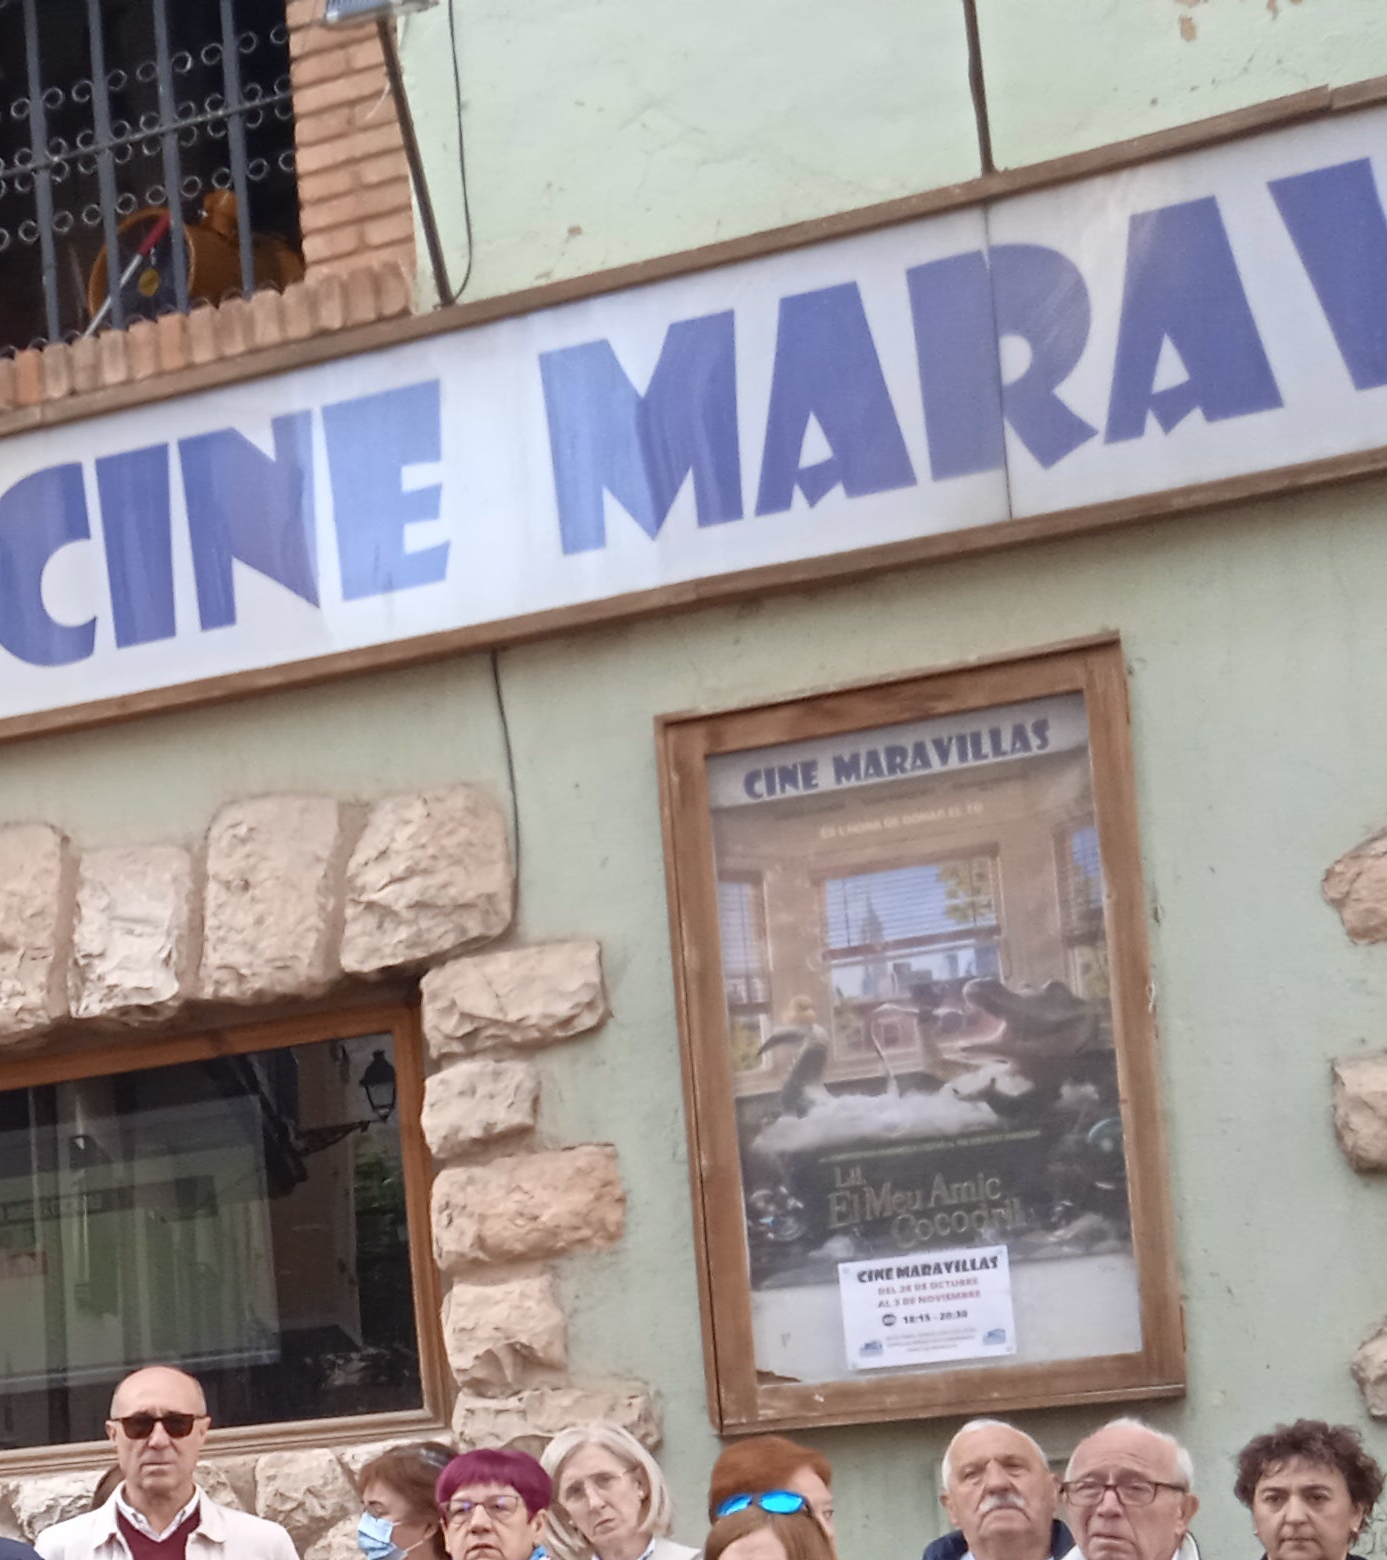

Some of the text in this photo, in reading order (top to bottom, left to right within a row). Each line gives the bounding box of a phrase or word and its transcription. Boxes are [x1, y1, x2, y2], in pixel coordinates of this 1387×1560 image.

[743, 718, 1050, 800] CINE MARAVILLAS
[928, 1171, 1002, 1208] Amic
[857, 1256, 998, 1284] CINE MARAVILLAS
[930, 1277, 979, 1290] OCTUBRE
[902, 1296, 916, 1306] DE
[918, 1289, 982, 1304] NOVIEMBRE
